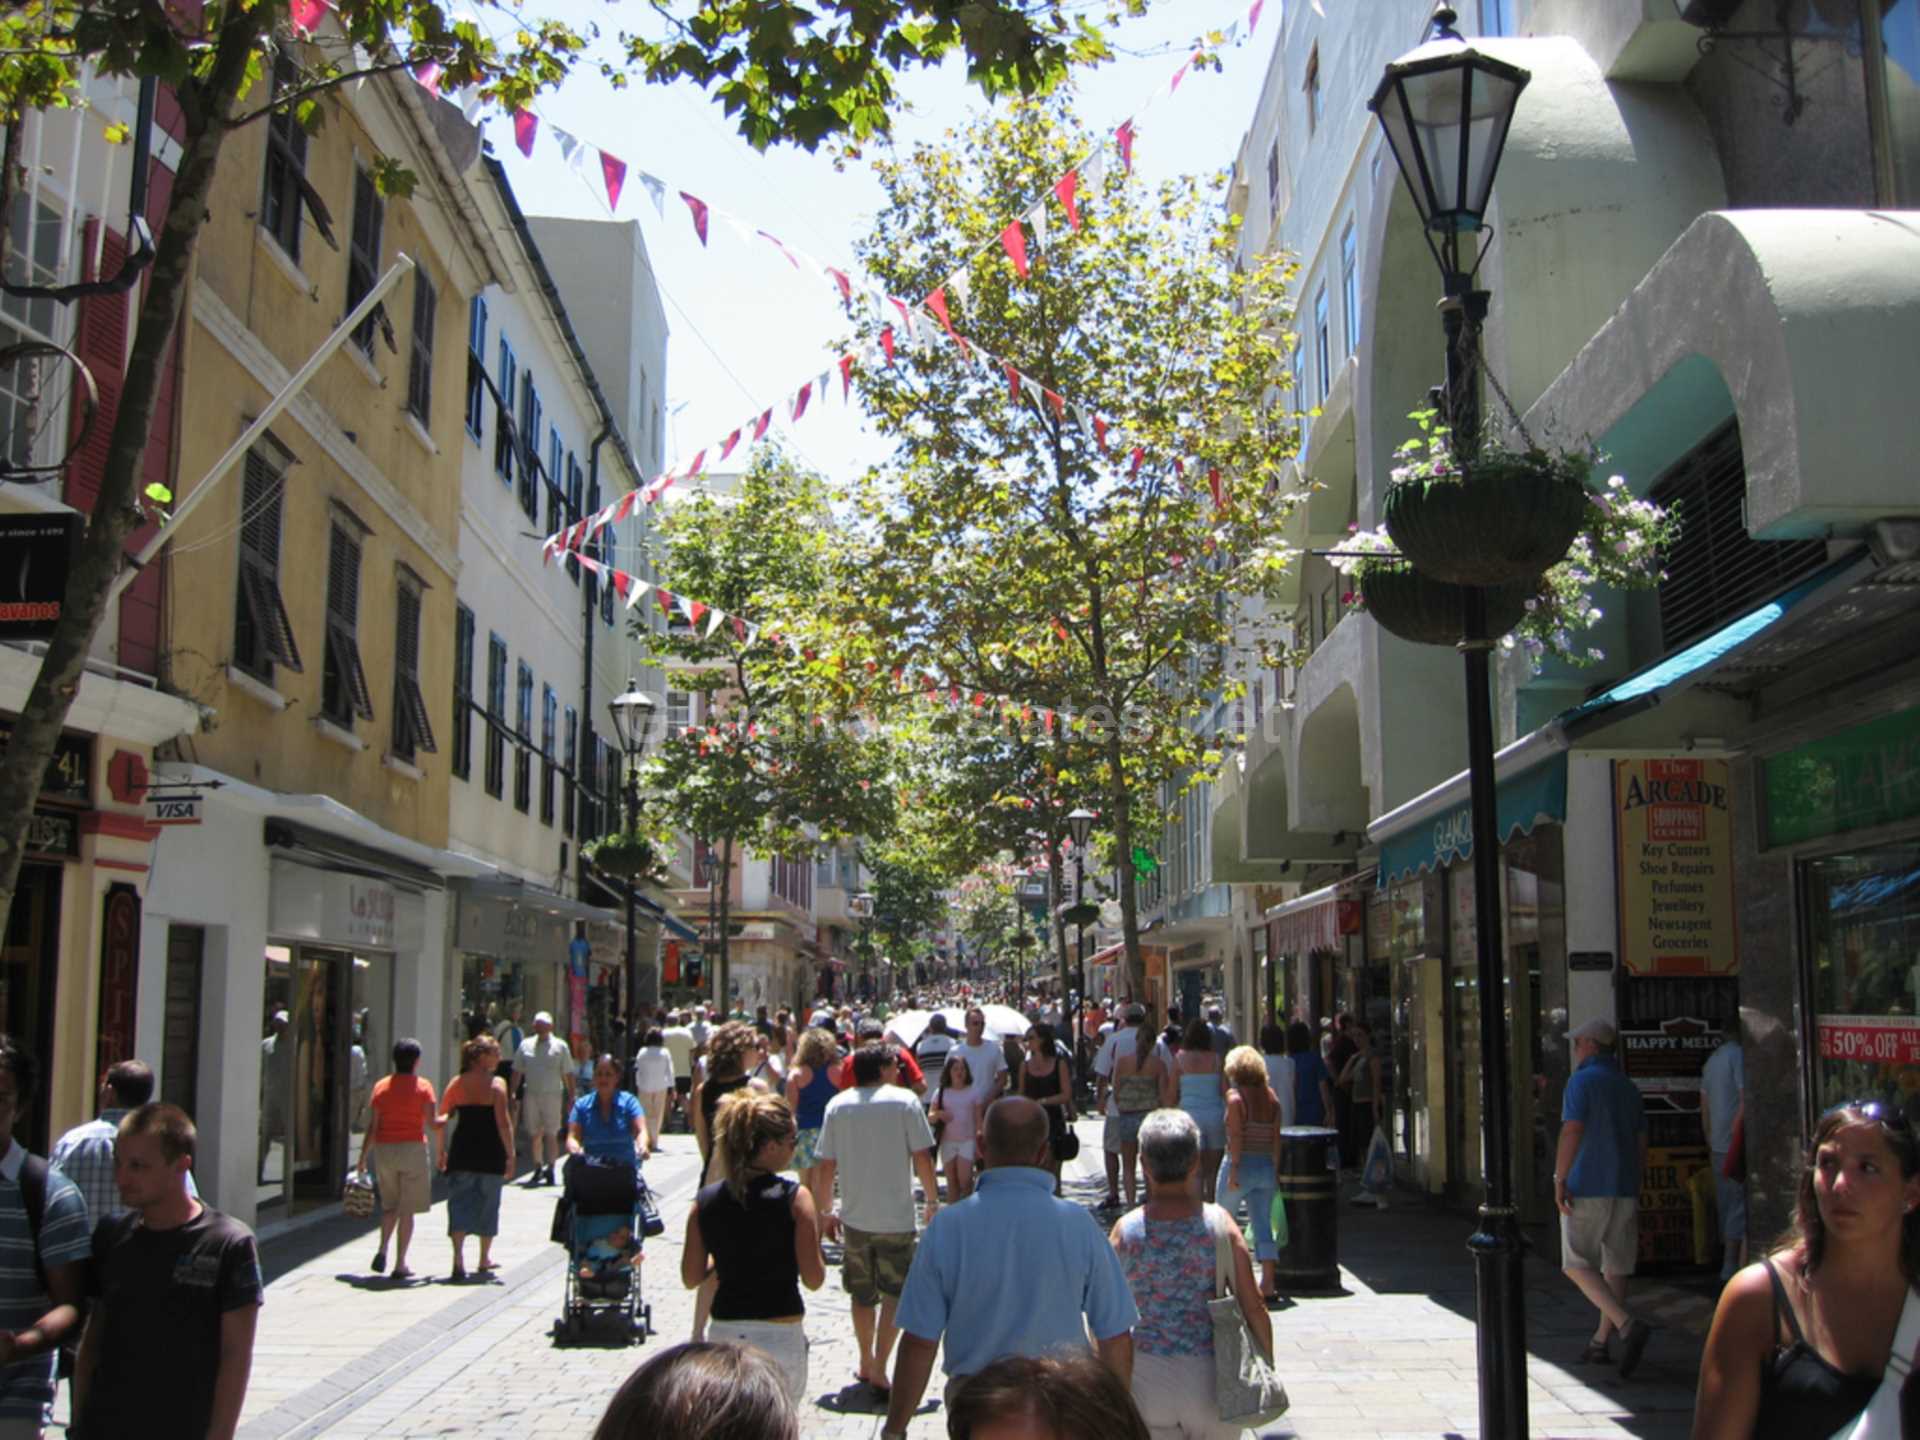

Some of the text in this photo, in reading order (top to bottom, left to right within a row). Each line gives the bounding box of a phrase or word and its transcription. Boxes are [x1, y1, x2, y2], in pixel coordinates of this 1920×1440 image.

[1661, 761, 1689, 775] The
[1623, 774, 1728, 811] ARCADE
[156, 803, 194, 818] VISA
[1642, 843, 1711, 858] Key Cutters
[1640, 861, 1714, 877] Shoe Repairs
[1652, 880, 1704, 894] Perfumes
[1652, 898, 1705, 914] Jewellery
[1648, 917, 1712, 932] Newsagent
[1652, 935, 1709, 949] Groceries
[1626, 1037, 1680, 1049] HAPPY
[1832, 1031, 1898, 1059] 50% OFF
